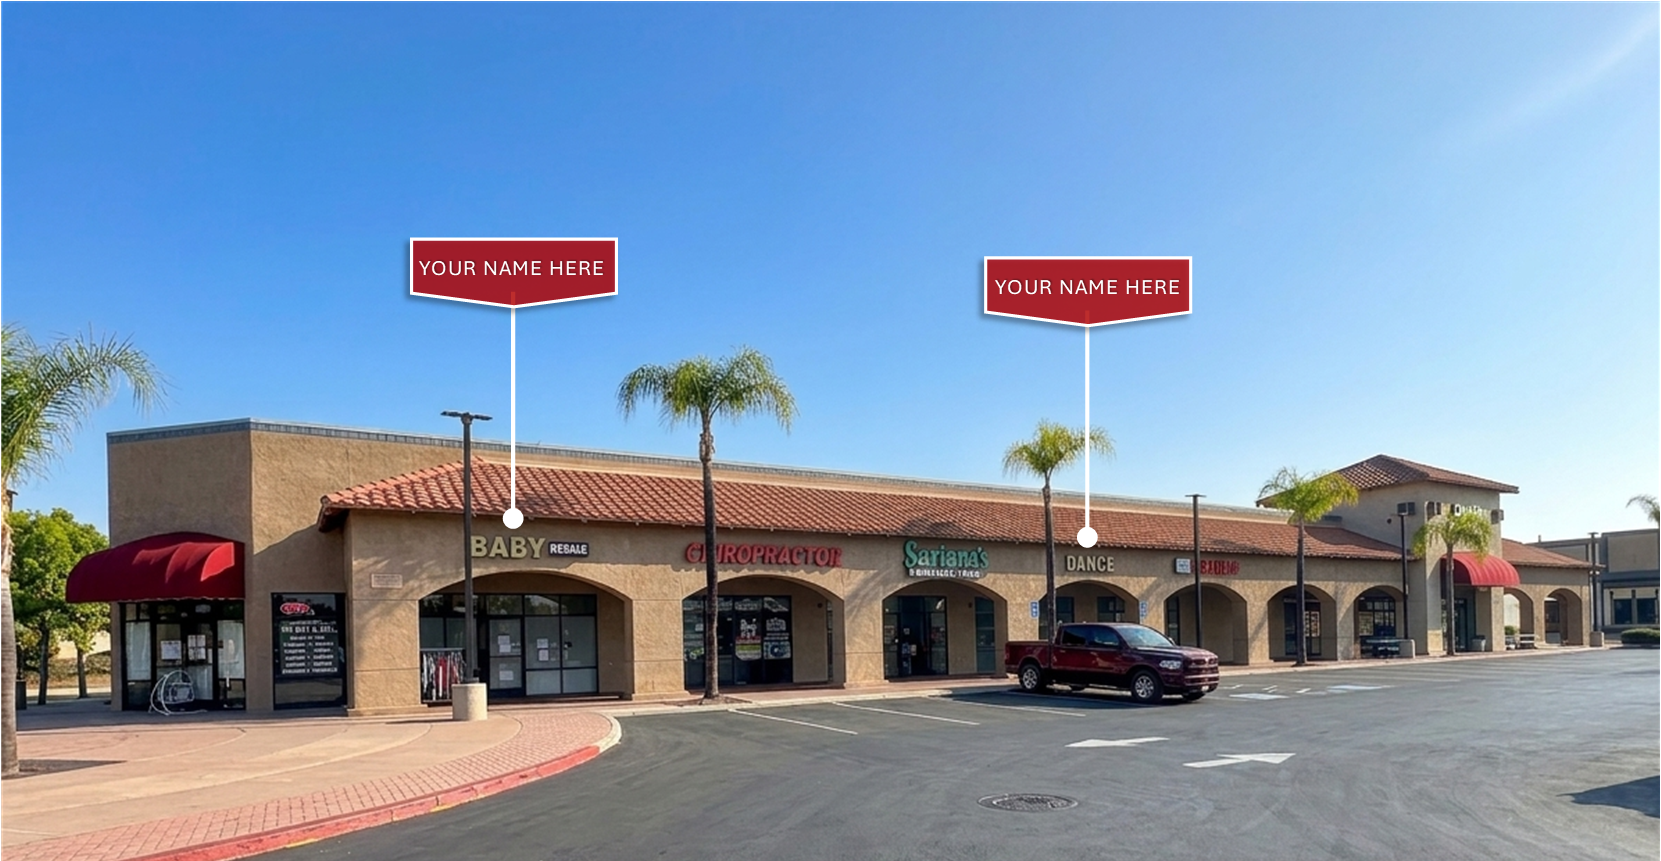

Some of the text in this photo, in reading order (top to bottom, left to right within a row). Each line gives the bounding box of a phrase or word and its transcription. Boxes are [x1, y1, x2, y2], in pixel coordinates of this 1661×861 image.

[471, 535, 588, 558] BABY RESALE
[905, 540, 989, 569] Sariana's
[1066, 555, 1115, 572] DANCE
